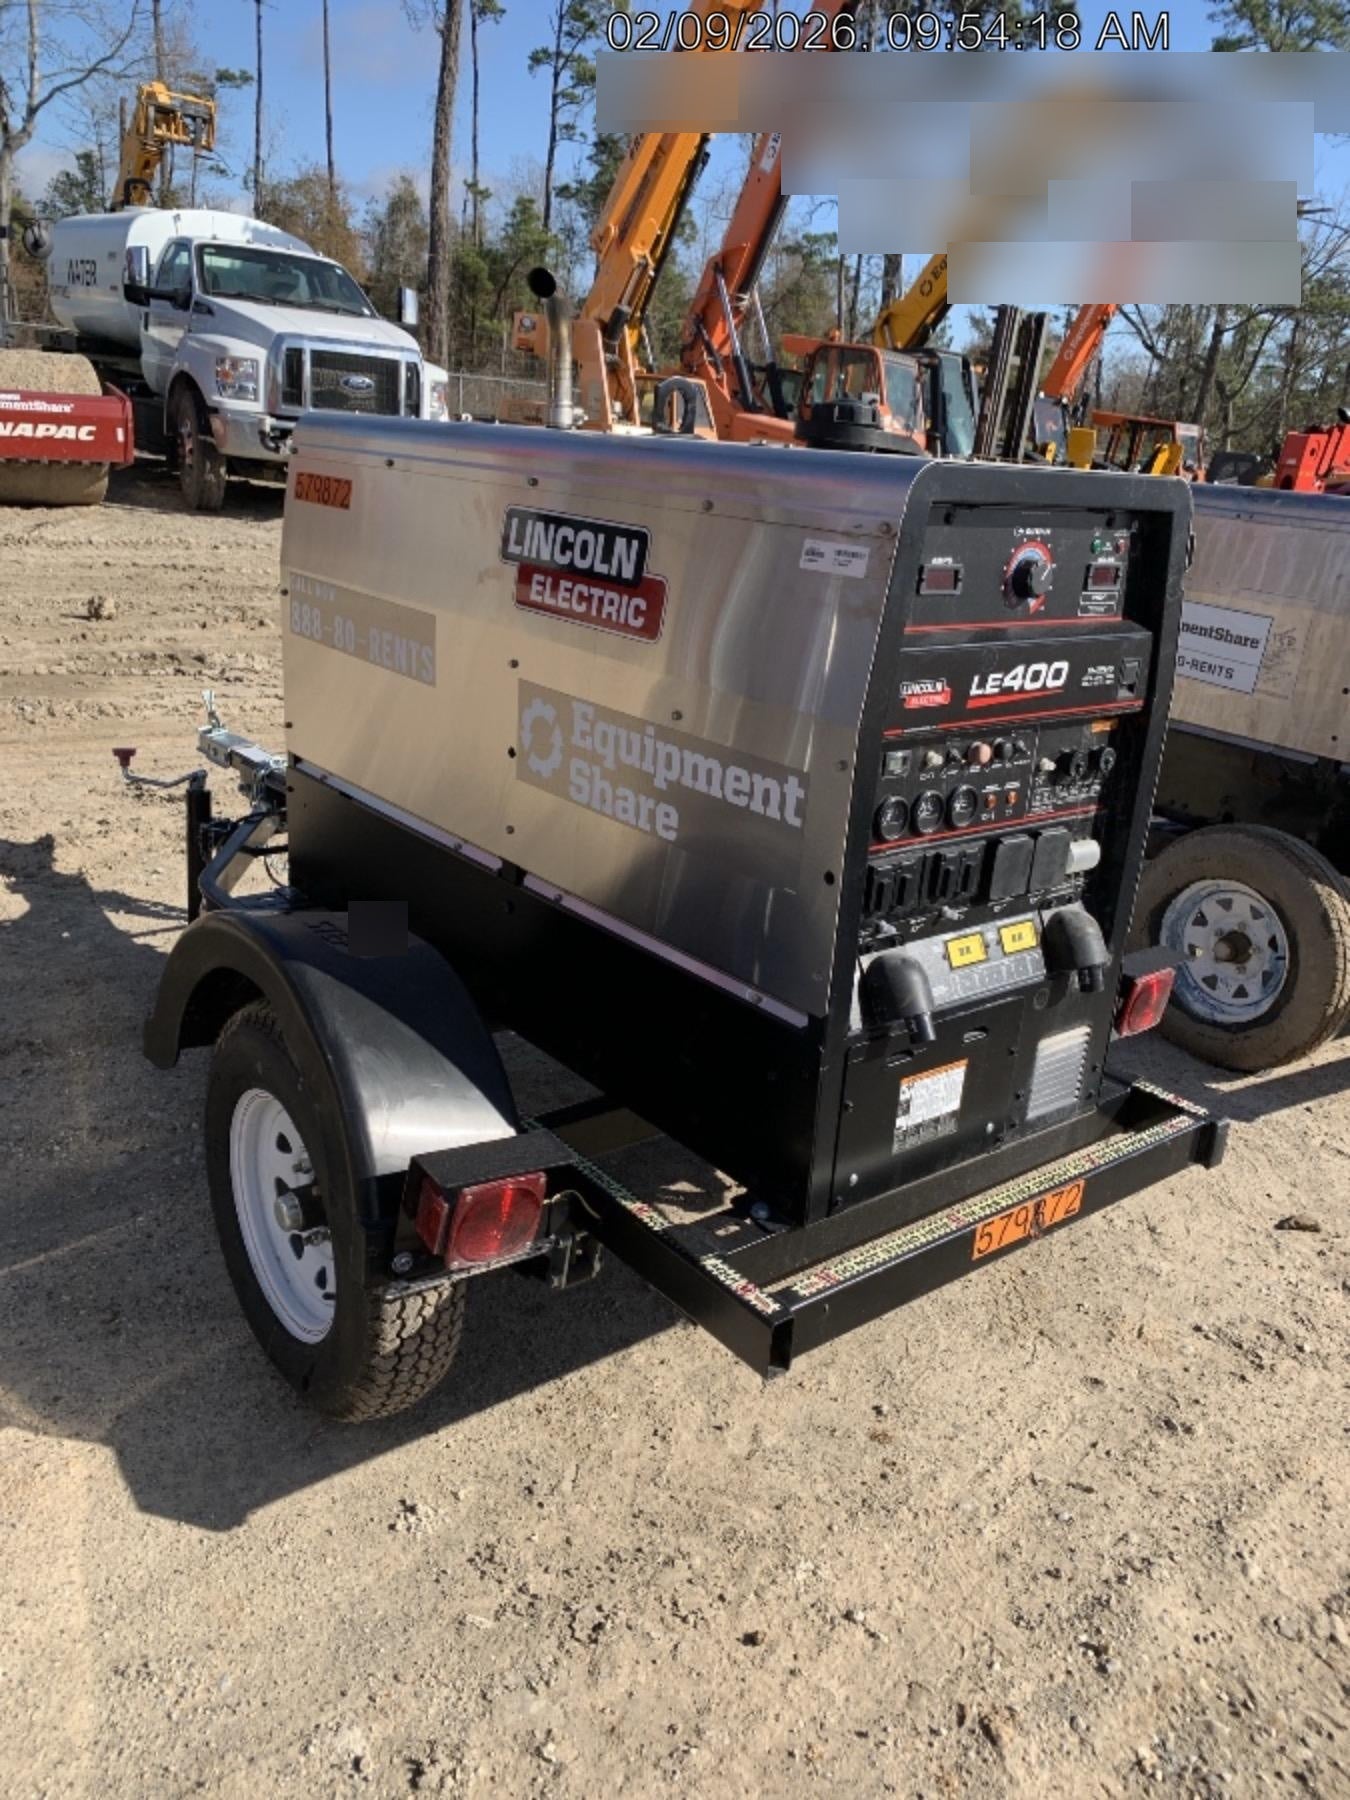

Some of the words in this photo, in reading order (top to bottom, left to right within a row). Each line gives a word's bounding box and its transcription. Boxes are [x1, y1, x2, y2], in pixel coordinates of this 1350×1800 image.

[295, 472, 352, 509] 579872
[507, 517, 639, 580] LINCOLN
[529, 573, 647, 628] ELECTRIC
[901, 681, 944, 695] LINCOLN
[969, 660, 1070, 697] LE400
[571, 701, 805, 829] Equipment
[569, 757, 680, 842] Share
